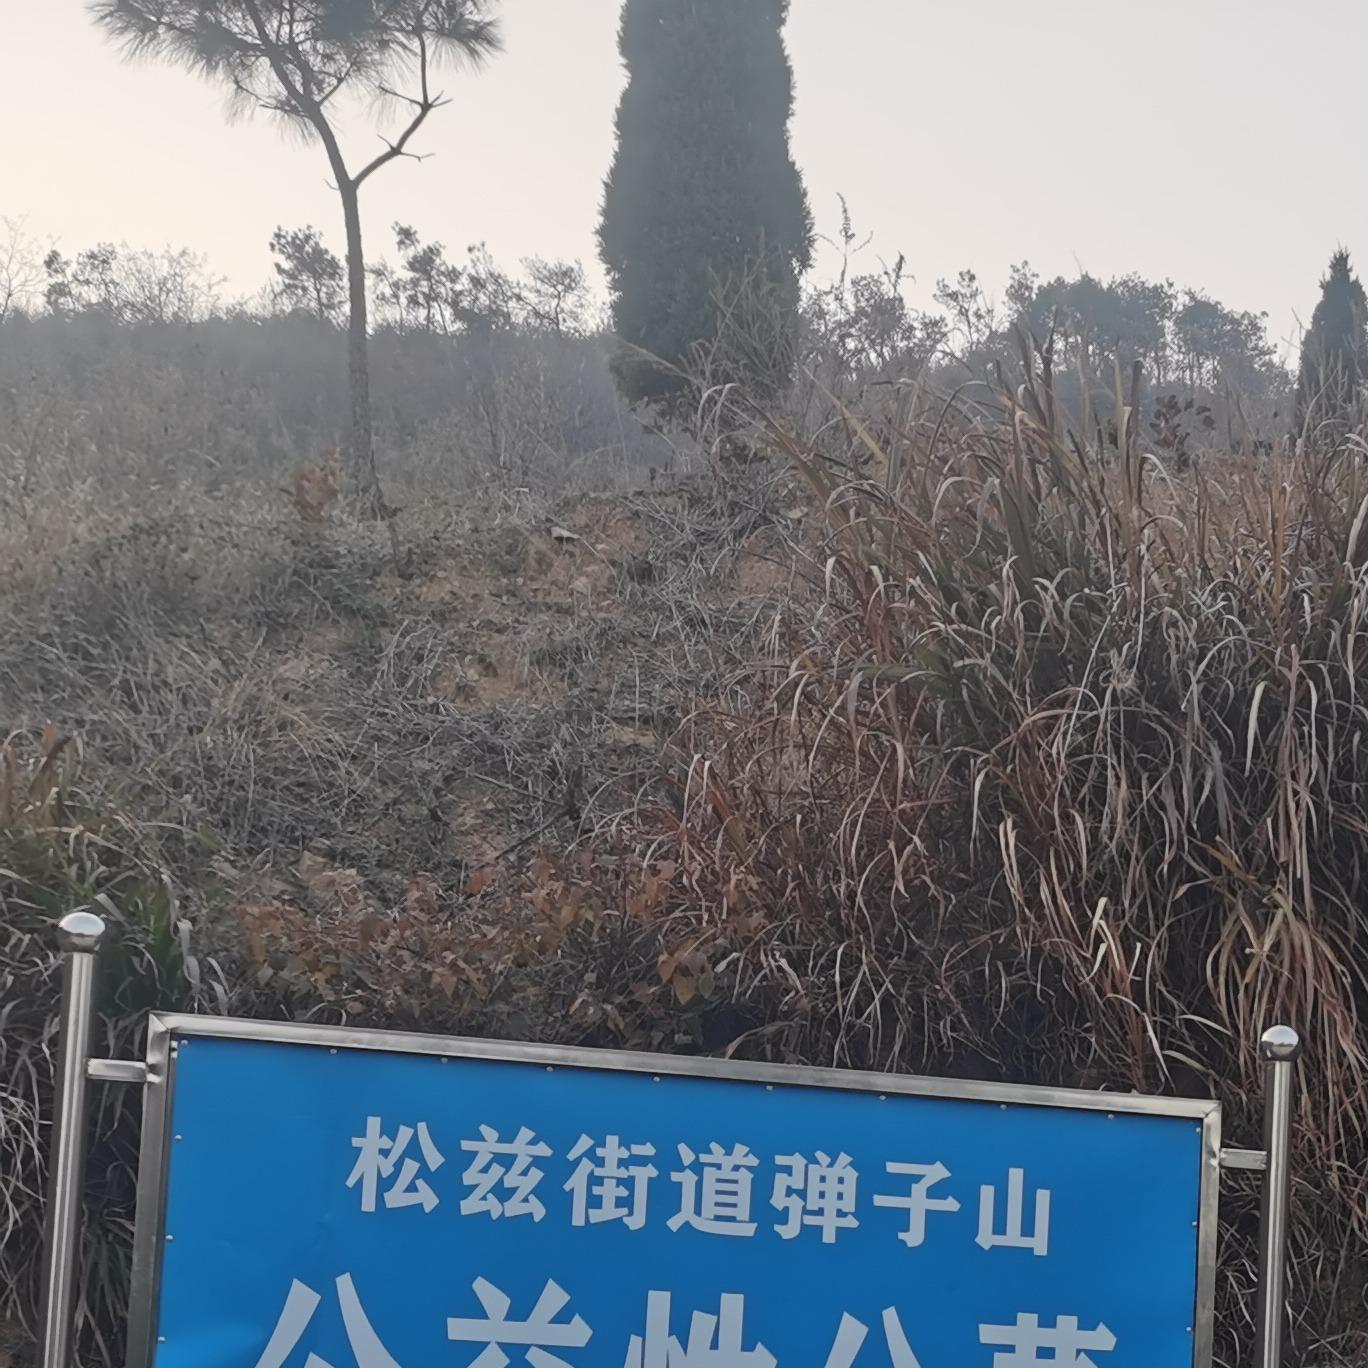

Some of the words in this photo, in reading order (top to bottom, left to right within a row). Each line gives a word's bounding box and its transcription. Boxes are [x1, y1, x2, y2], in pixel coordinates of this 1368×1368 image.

[346, 1115, 1053, 1257] 松兹街道弹子山
